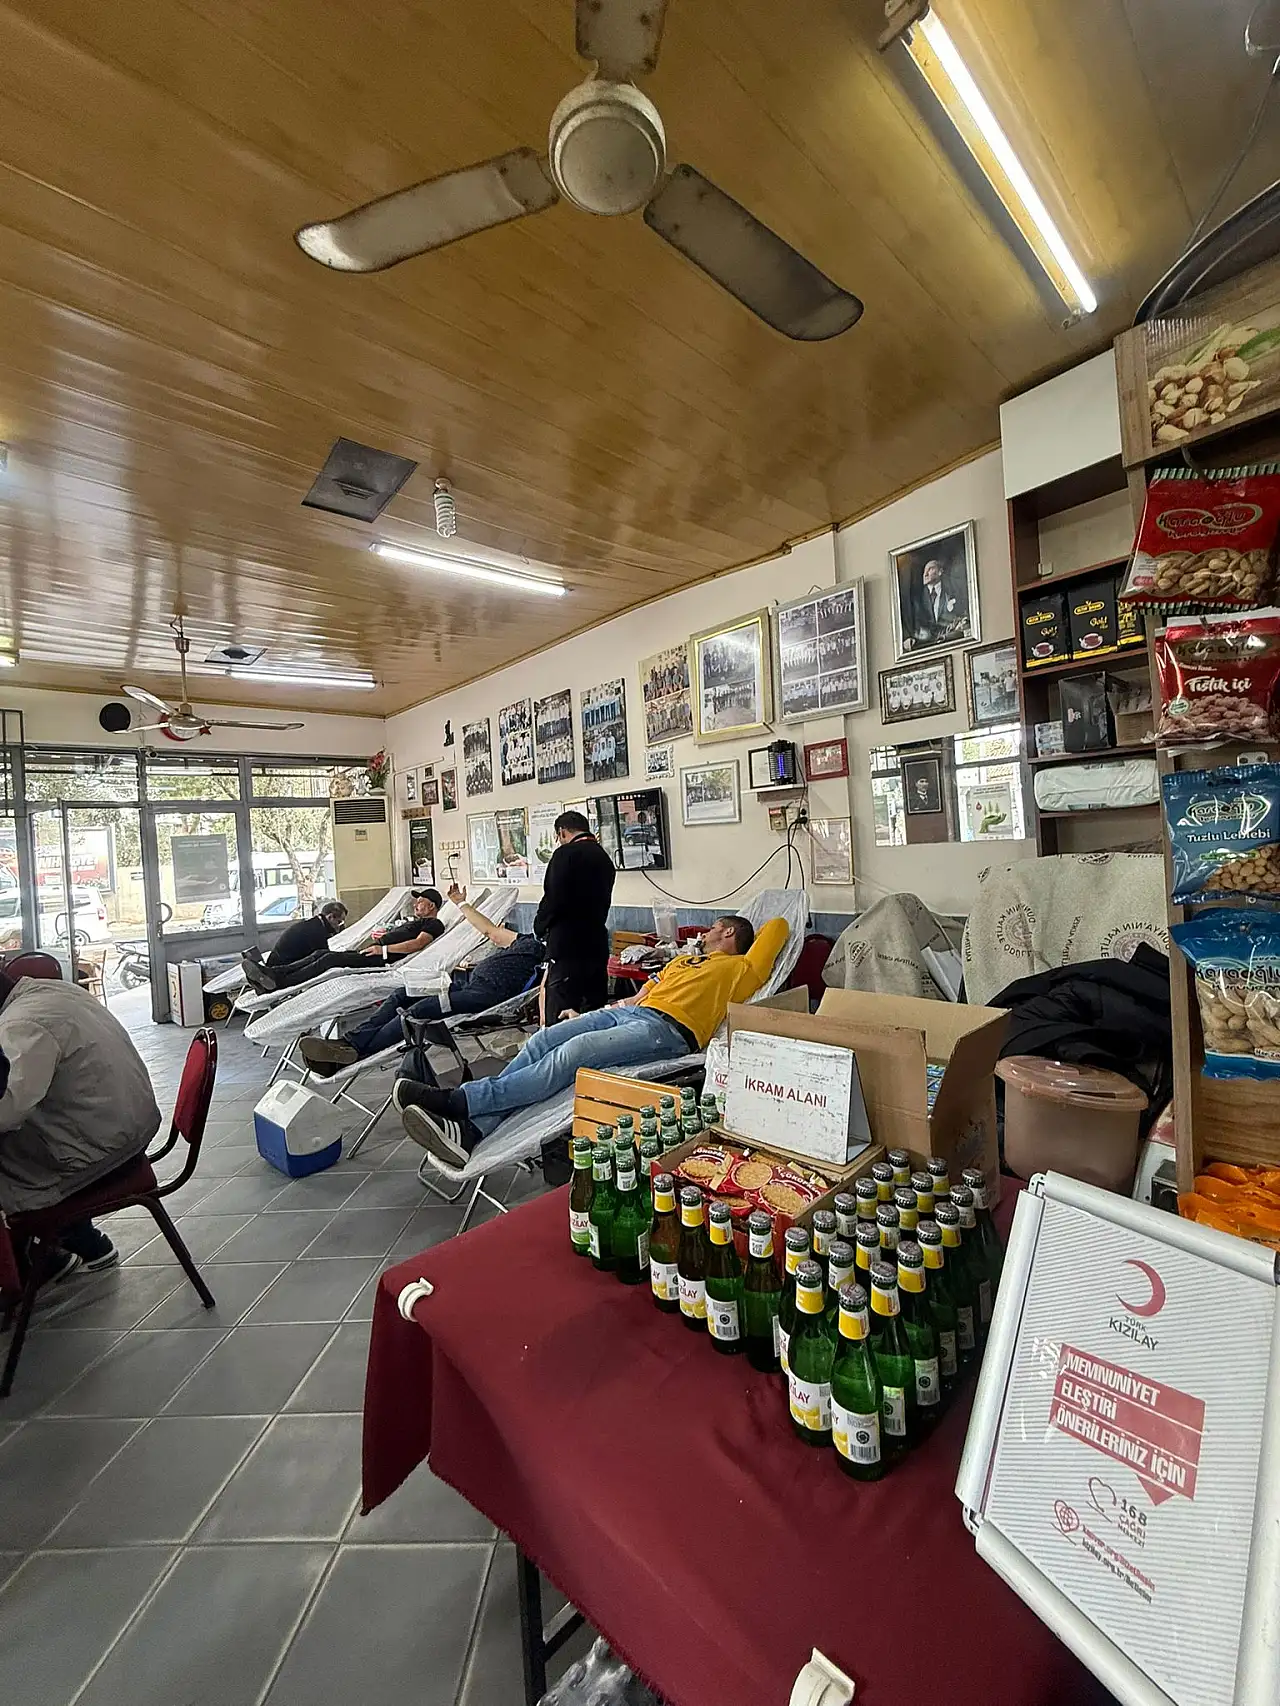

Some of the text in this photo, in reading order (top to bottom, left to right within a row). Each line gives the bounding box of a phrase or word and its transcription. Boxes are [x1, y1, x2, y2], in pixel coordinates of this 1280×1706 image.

[1187, 831, 1220, 842] Tuzlu
[744, 1075, 827, 1108] İKRAM ALANI
[1109, 1316, 1159, 1351] KIZILAY
[1066, 1352, 1161, 1407] MEMNUNİYET
[1061, 1379, 1118, 1421] ELEŞTİRİ
[1056, 1404, 1187, 1488] ÖNERİLERİNİZ İÇİN
[1121, 1499, 1148, 1527] 168
